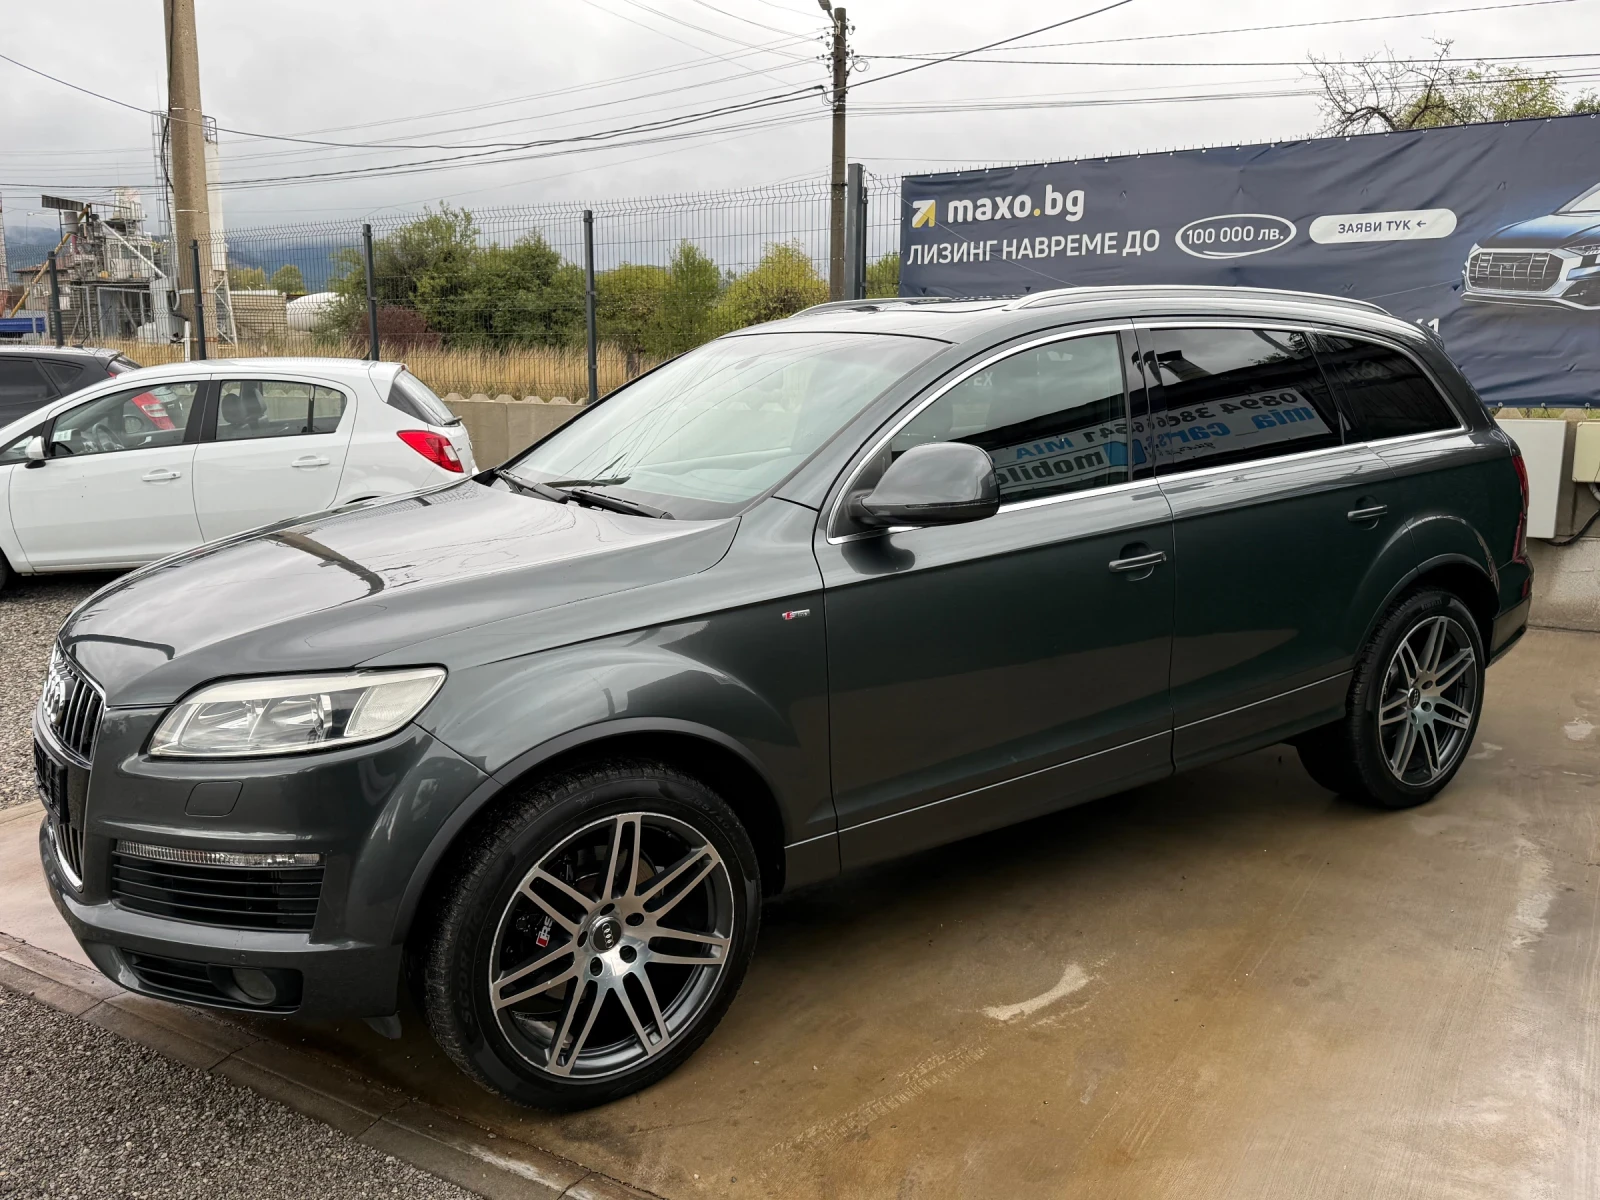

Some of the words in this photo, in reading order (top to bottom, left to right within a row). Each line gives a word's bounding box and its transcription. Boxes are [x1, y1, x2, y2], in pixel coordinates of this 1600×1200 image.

[947, 184, 1085, 222] maxo.bg
[906, 240, 997, 265] ЛИЗИНГ
[1002, 232, 1118, 260] НАВРЕМЕ
[1122, 229, 1161, 256] ДО
[1186, 228, 1216, 244] 100
[1219, 226, 1255, 243] 000
[1257, 229, 1285, 241] лв.
[1337, 221, 1383, 234] ЗАЯВИ
[1386, 219, 1411, 232] ТУК
